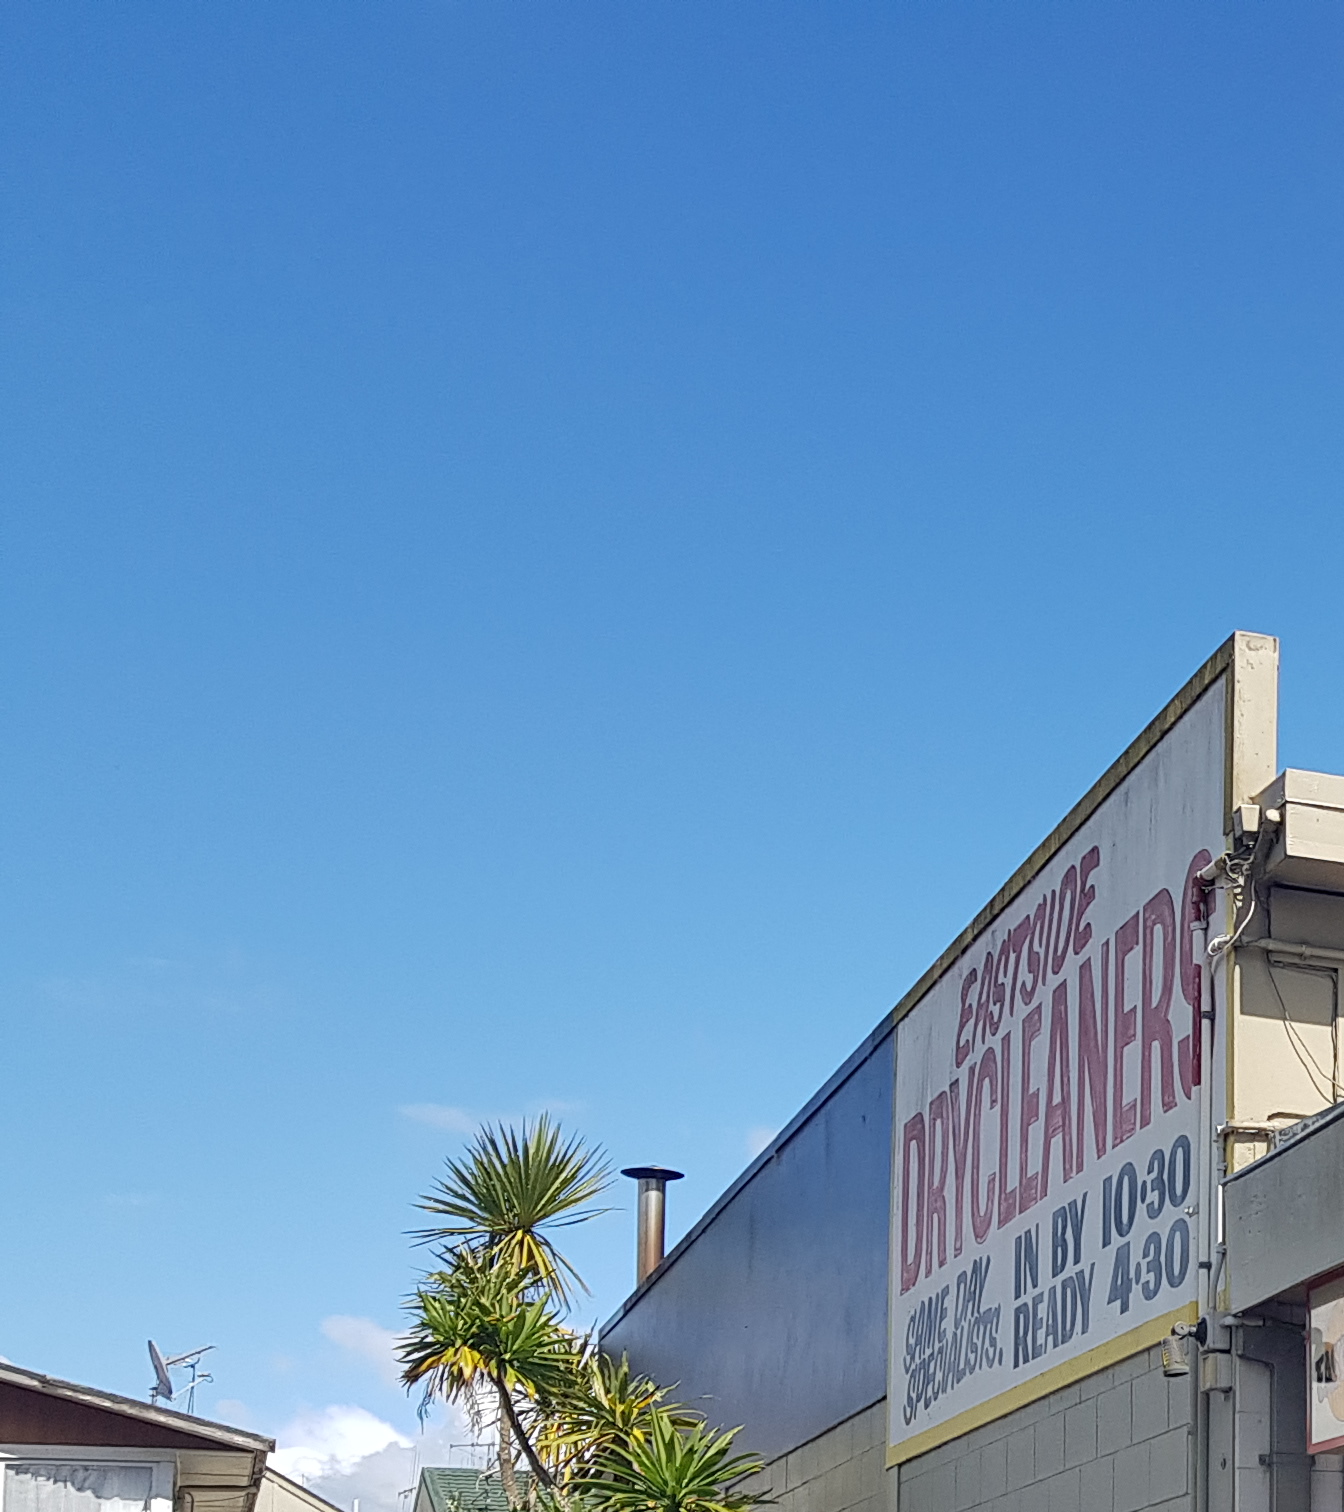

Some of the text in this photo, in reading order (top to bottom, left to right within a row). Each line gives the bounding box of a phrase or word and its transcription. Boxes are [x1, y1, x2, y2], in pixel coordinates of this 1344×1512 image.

[956, 845, 1100, 1069] EASTSIDE
[900, 849, 1216, 1297] DRYCLEANERS
[1014, 1222, 1040, 1301] IN
[1051, 1190, 1089, 1280] BY
[903, 1254, 992, 1375] SAME DAY
[1013, 1261, 1096, 1370] READY
